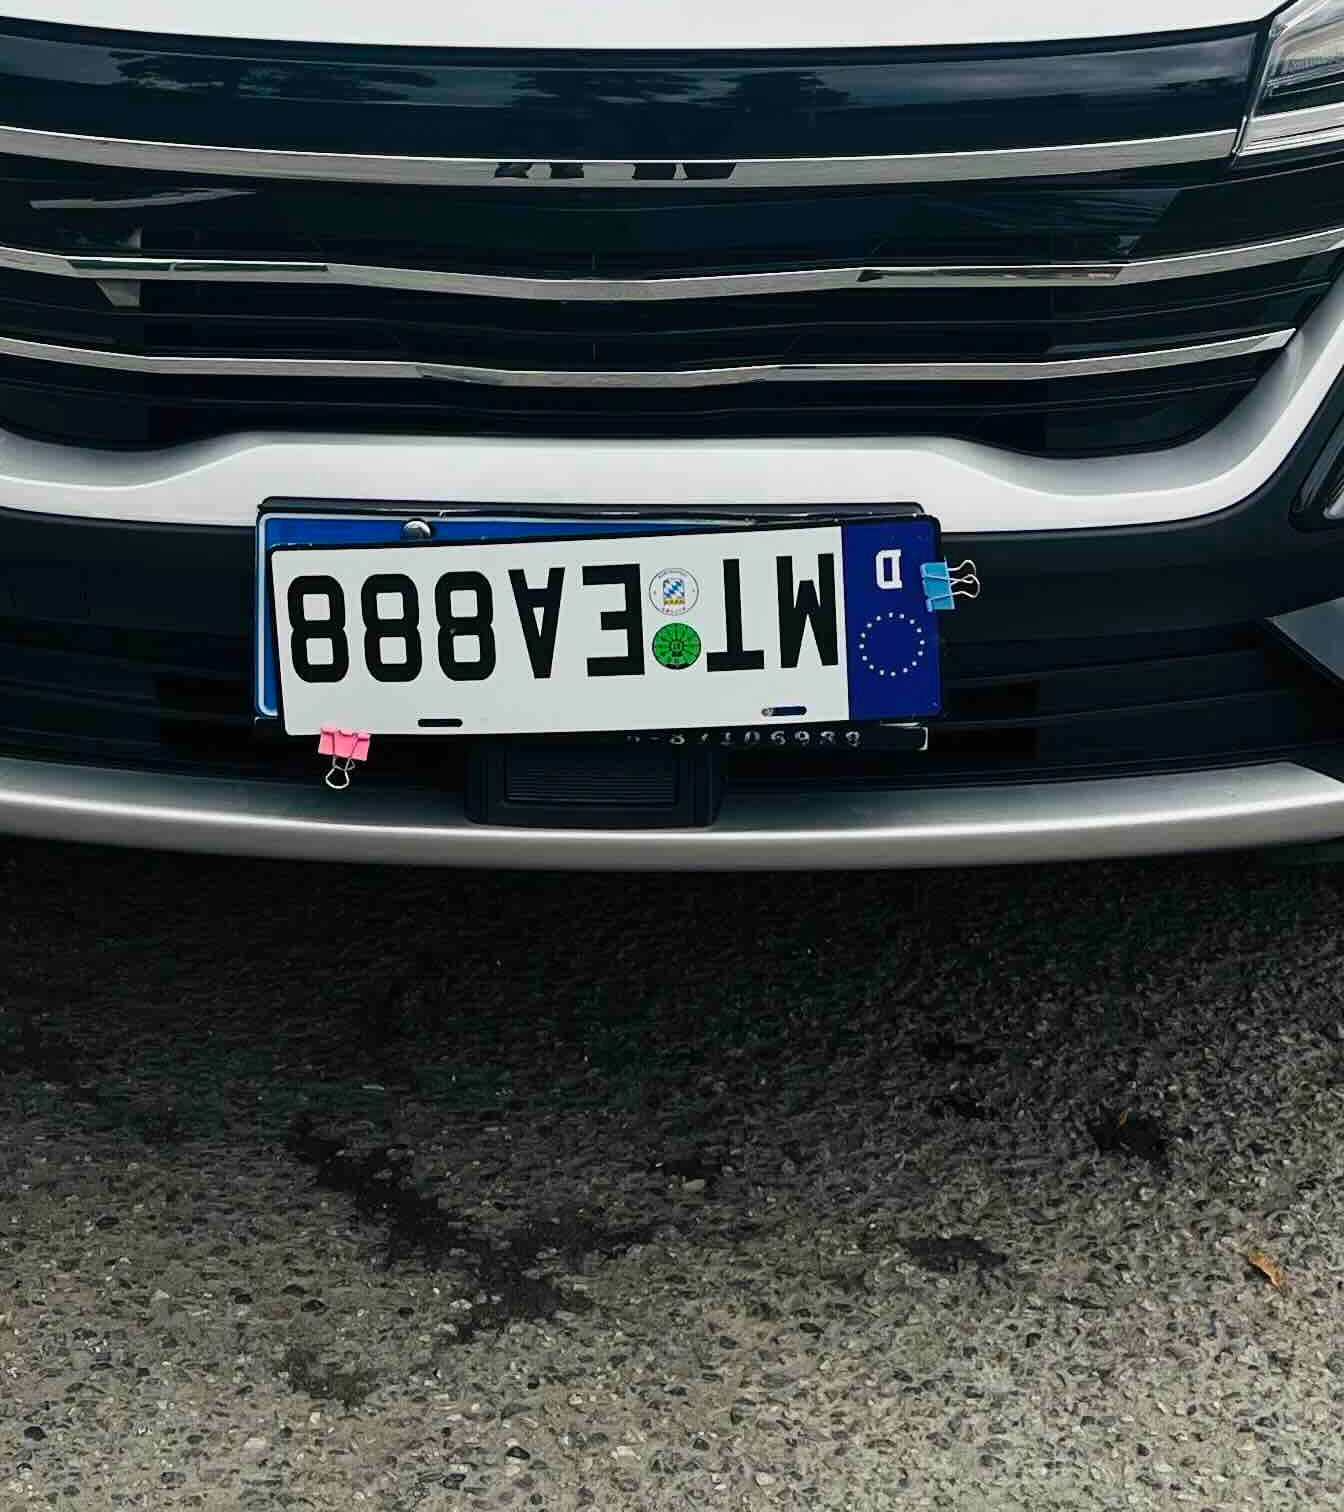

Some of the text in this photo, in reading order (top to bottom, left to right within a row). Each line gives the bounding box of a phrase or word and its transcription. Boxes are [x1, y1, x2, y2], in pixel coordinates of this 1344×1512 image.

[286, 563, 646, 683] EA888
[705, 553, 841, 673] MT
[875, 548, 902, 590] D
